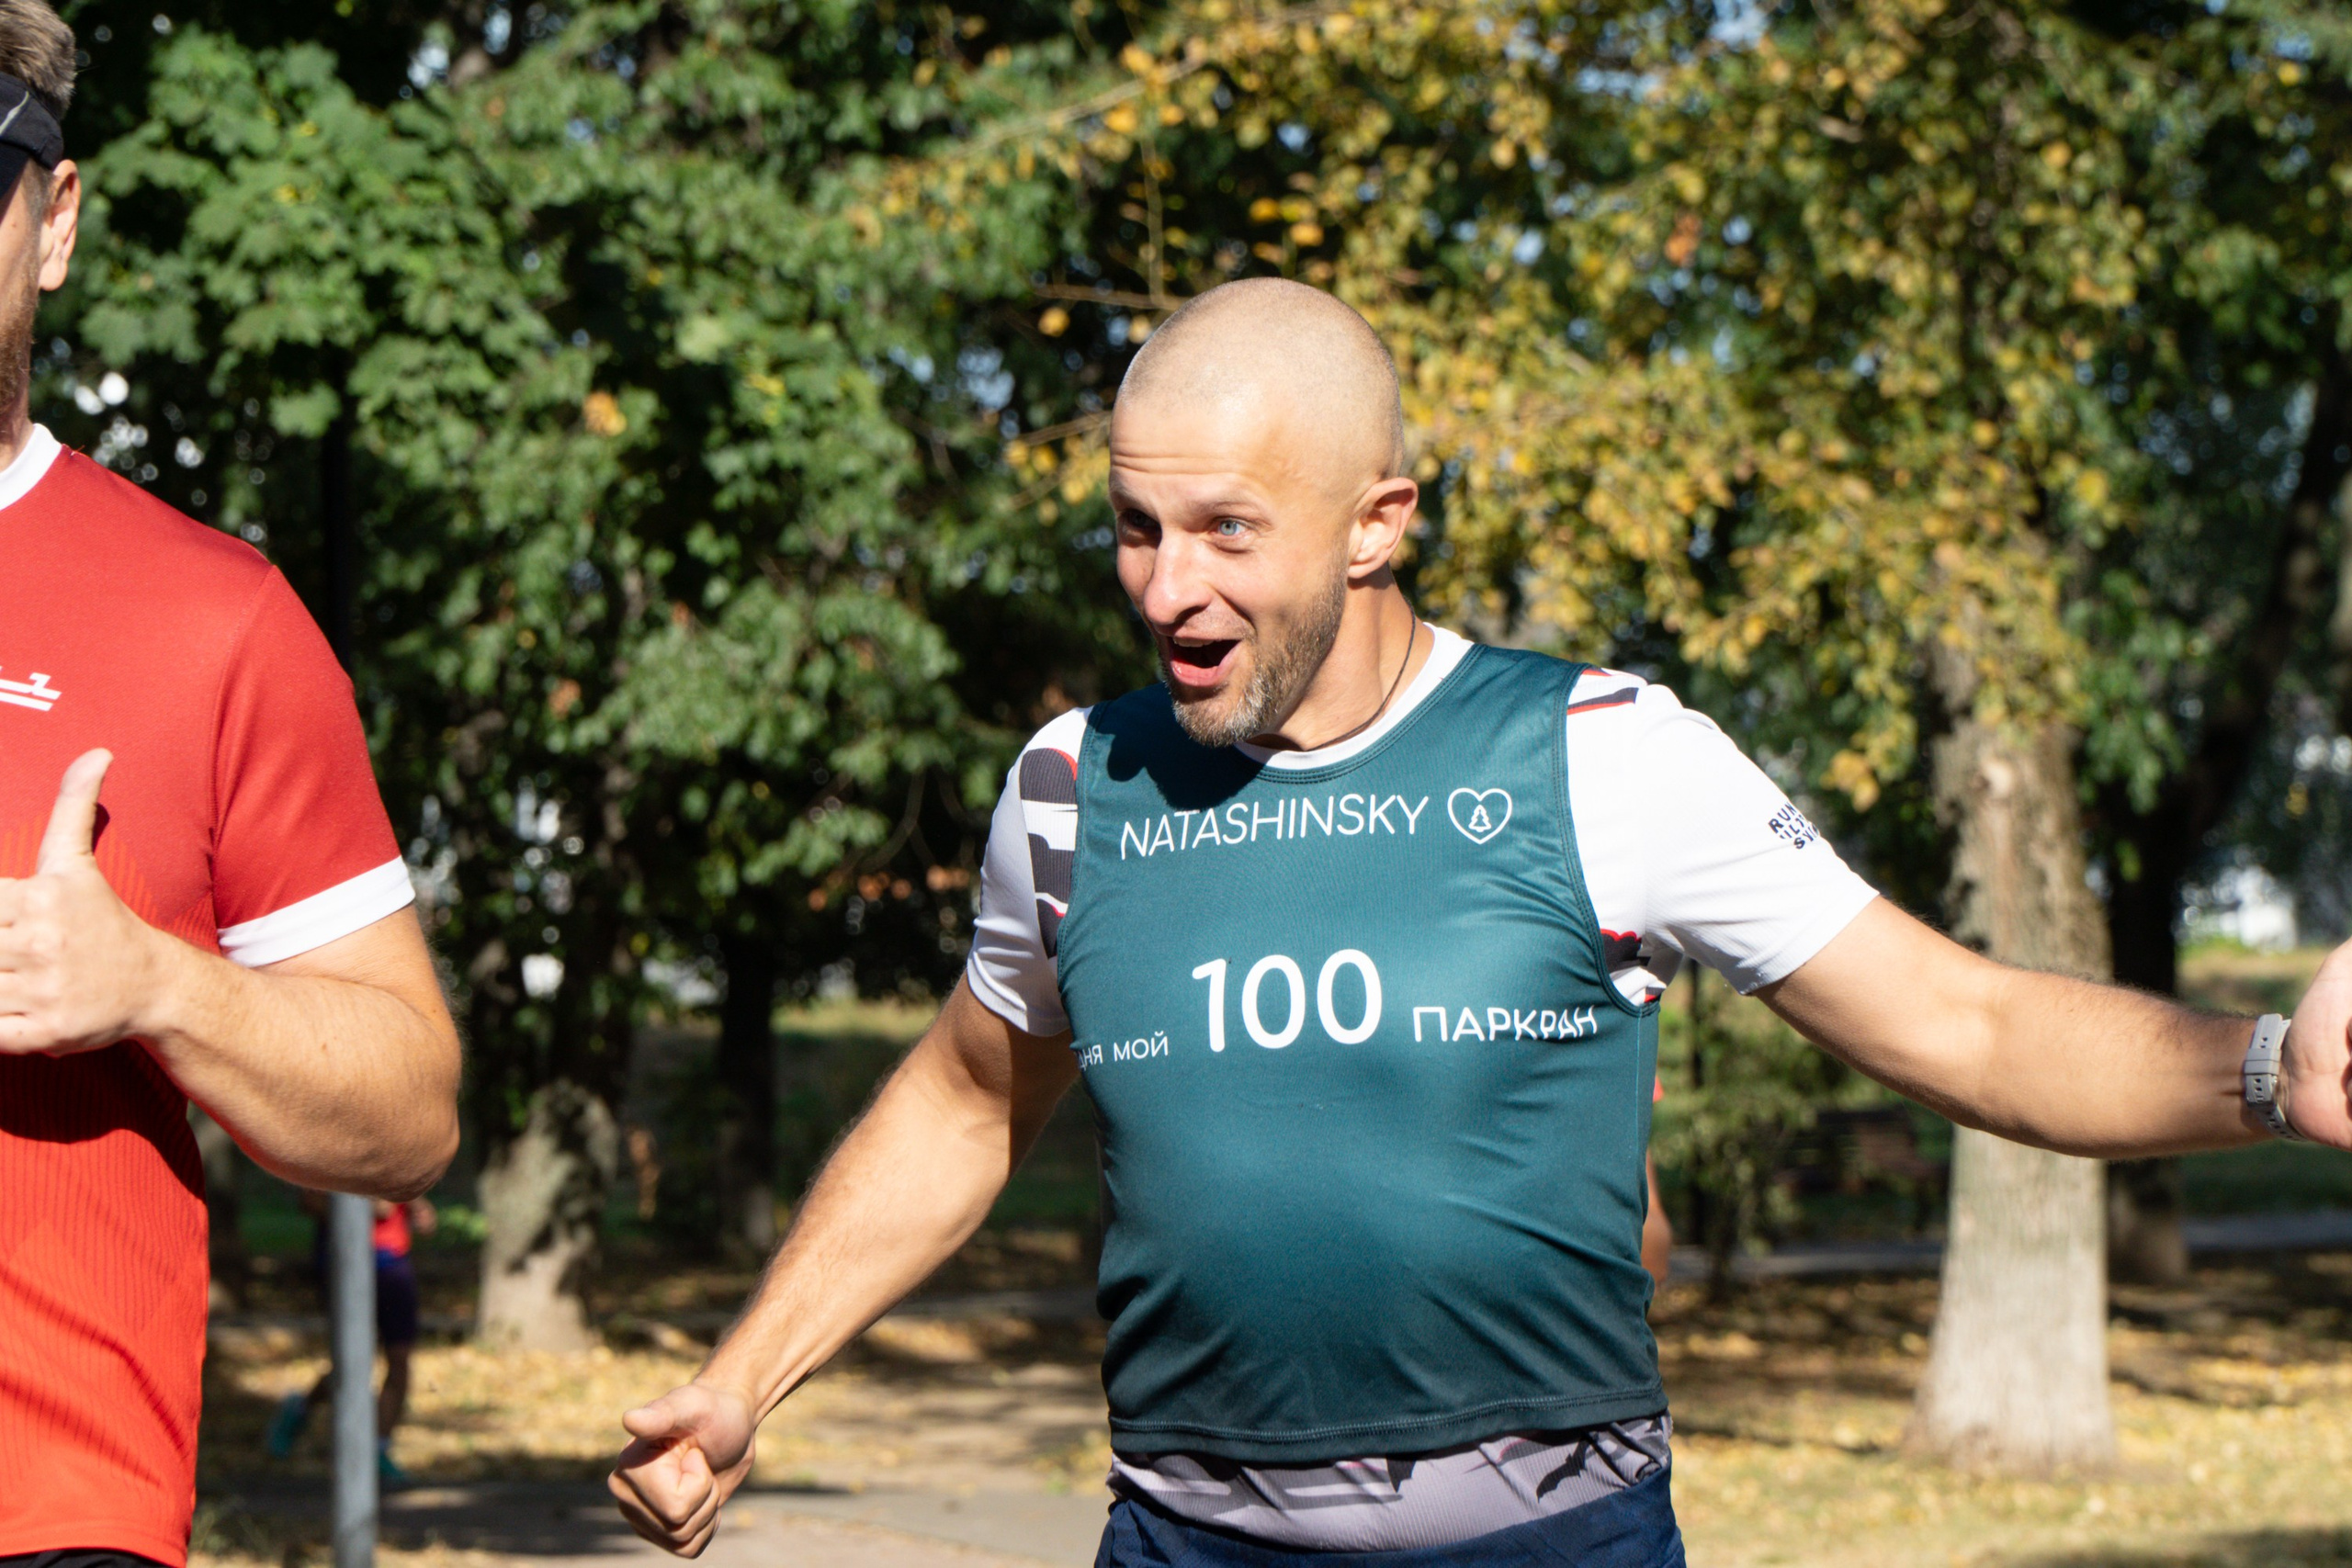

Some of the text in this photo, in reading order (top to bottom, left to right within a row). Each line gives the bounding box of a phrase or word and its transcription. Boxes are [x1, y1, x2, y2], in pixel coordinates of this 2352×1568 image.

[1120, 794, 1430, 861] NATASHINSKY
[1114, 1030, 1169, 1062] МОЙ
[1192, 948, 1383, 1053] 100
[1412, 1004, 1599, 1042] ПАРКРАН
